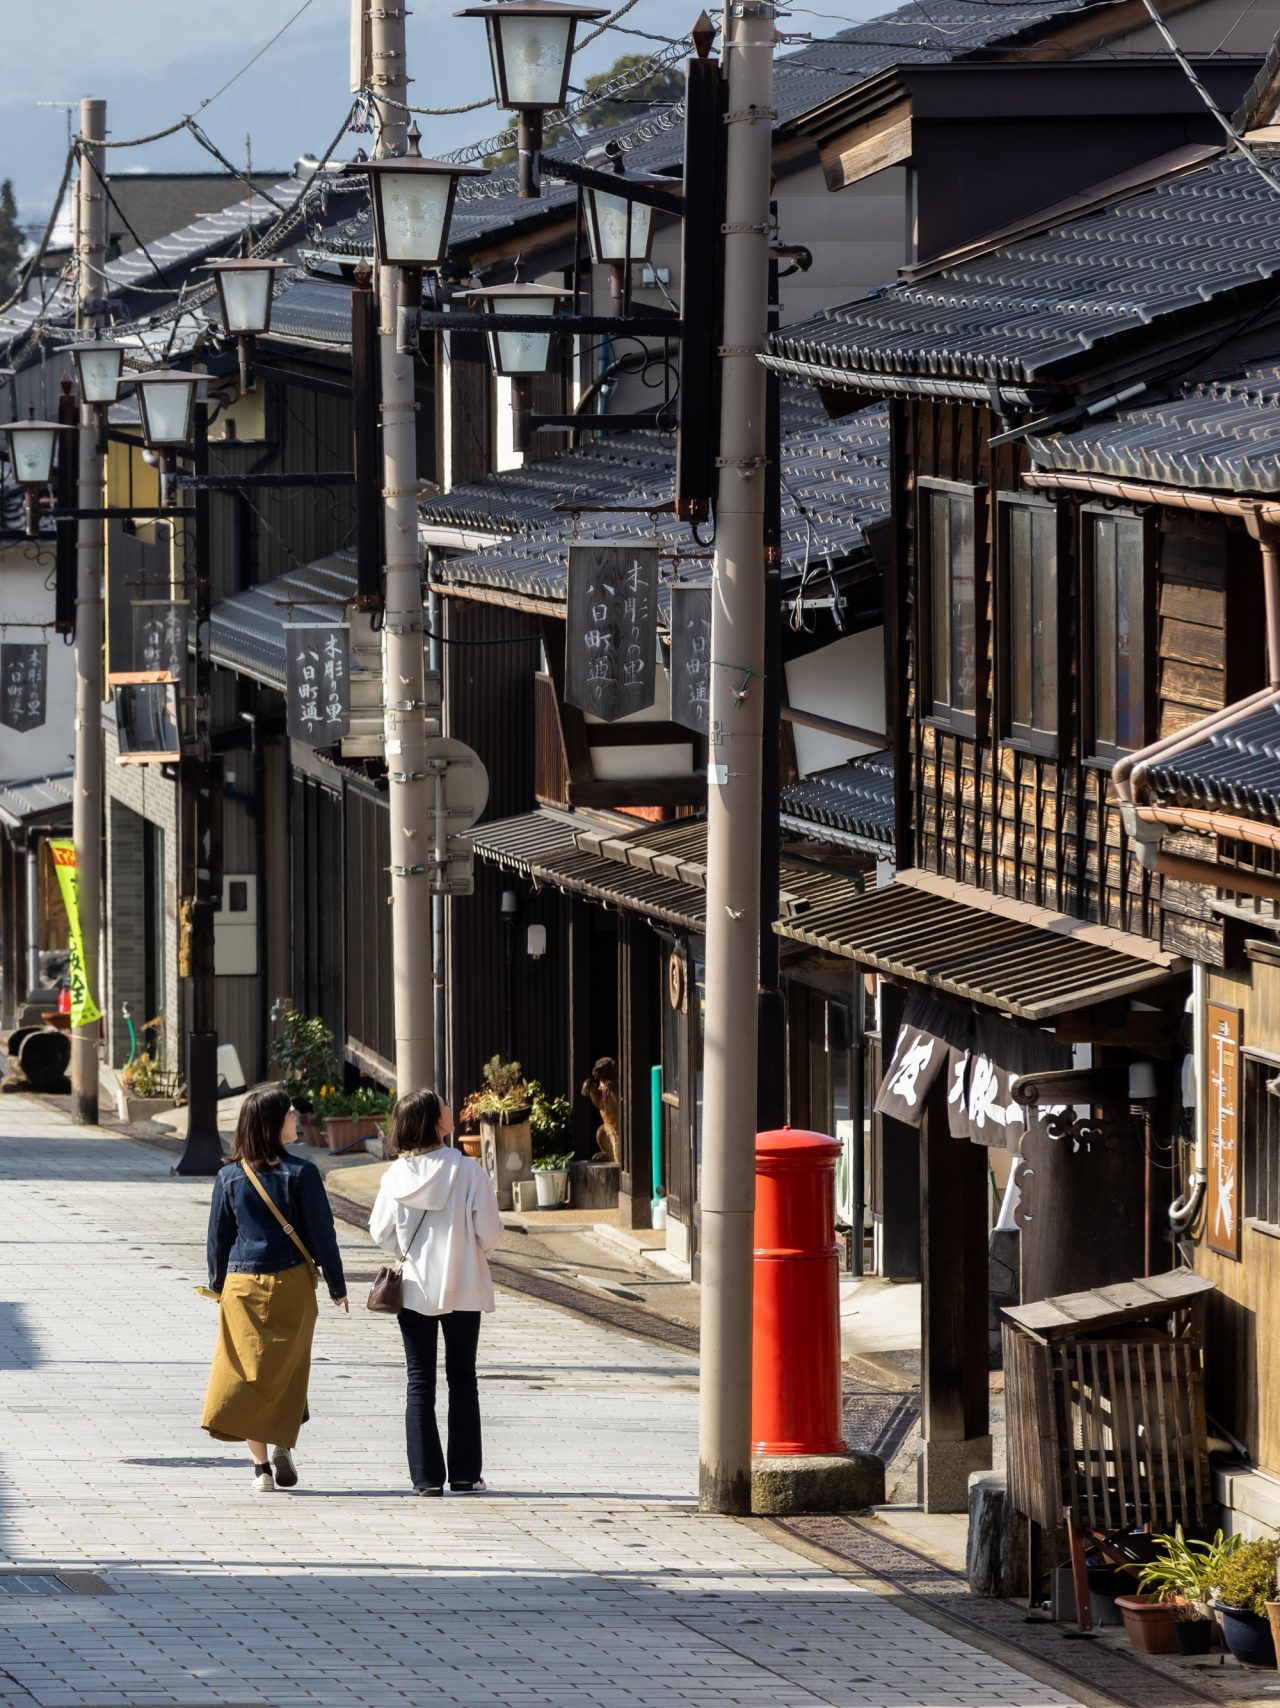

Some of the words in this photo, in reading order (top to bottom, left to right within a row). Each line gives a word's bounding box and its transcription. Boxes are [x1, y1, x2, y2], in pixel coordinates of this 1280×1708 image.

[584, 584, 618, 700] 八日町通り
[623, 559, 650, 686] 木彫りの里
[7, 661, 24, 723] 八日町通り
[28, 648, 42, 715] 木彫りの里
[296, 650, 324, 734] 八日町通り
[324, 633, 344, 723] 木彫りの里
